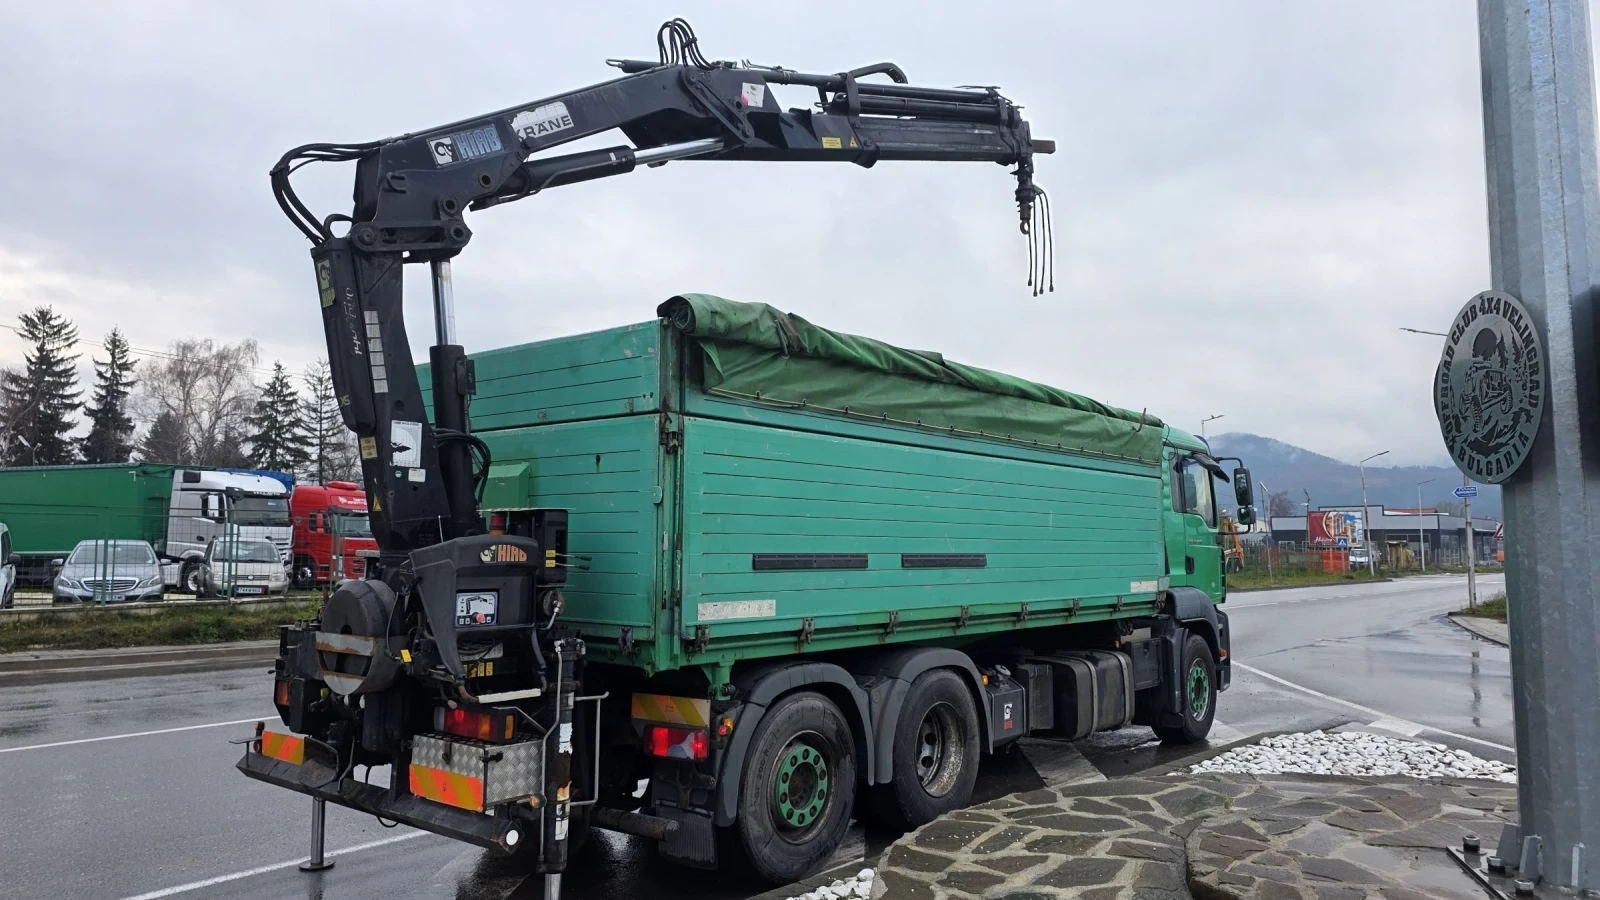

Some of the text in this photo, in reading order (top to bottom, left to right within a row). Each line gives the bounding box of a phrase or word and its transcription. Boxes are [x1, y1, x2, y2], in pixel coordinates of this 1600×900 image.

[1451, 304, 1478, 346] CLUB
[1502, 300, 1541, 409] VELINGRAD
[1458, 431, 1529, 477] BULGARIA
[498, 545, 527, 562] HIAB
